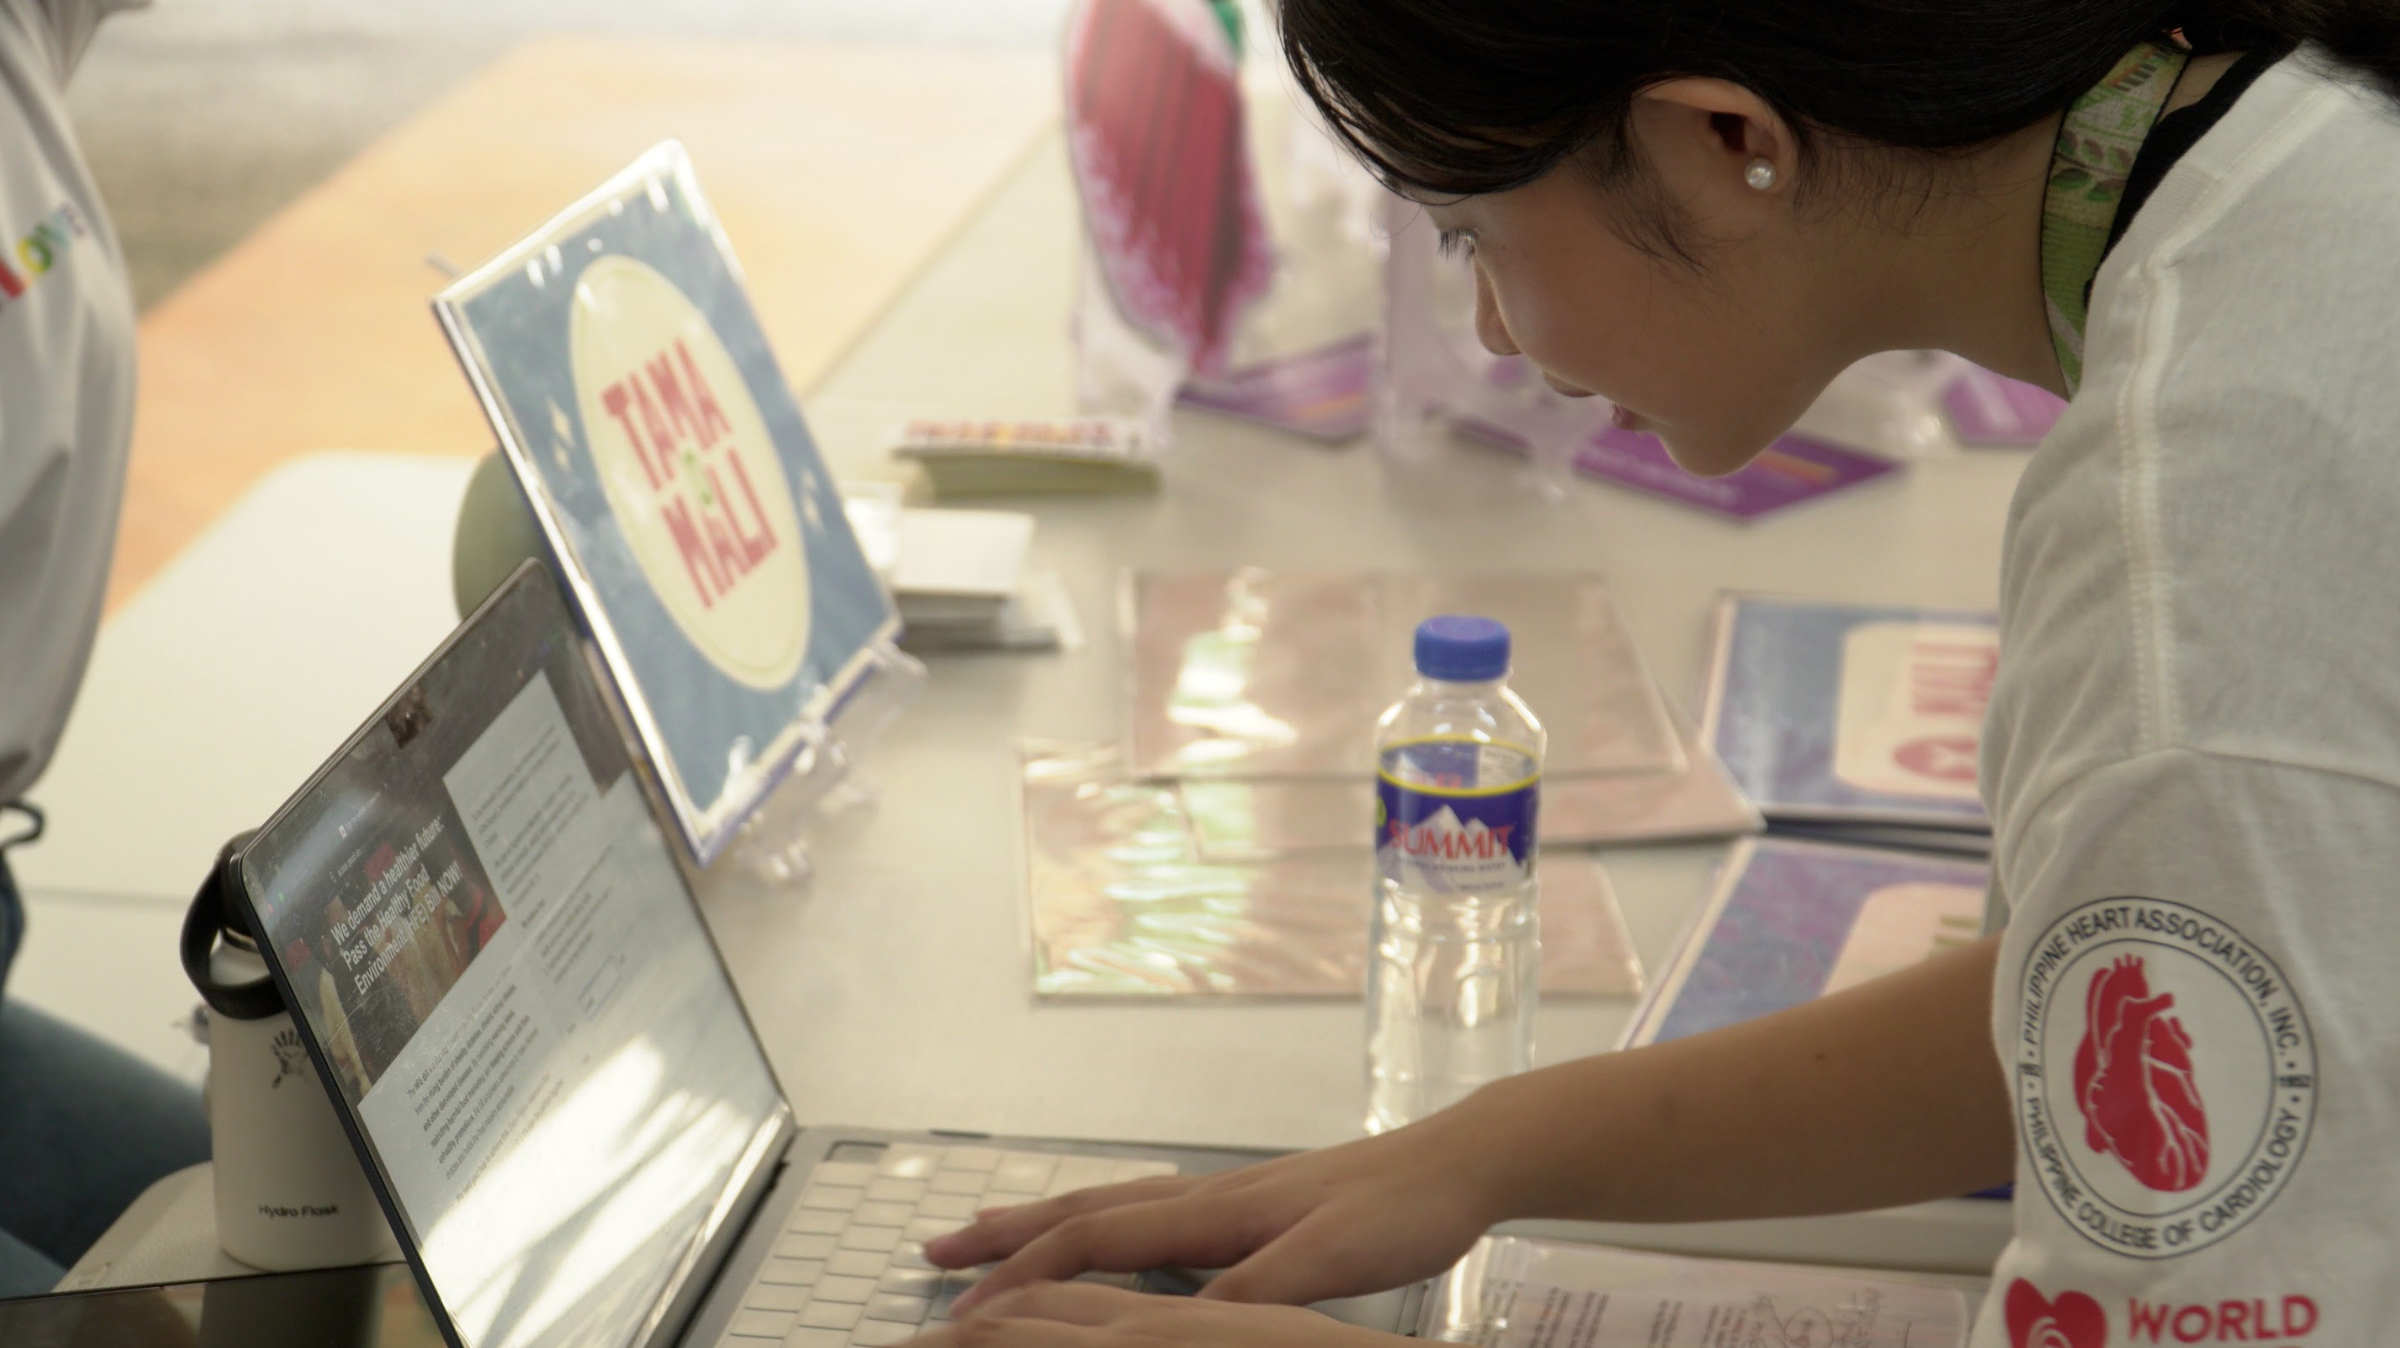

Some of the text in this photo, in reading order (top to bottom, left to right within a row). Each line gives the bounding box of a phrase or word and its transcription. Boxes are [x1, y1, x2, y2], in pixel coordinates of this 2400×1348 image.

[602, 338, 732, 491] TAMA
[661, 447, 778, 610] MALI
[330, 810, 444, 948] We demand a healthier future:
[1389, 819, 1514, 859] SUMMIT
[341, 861, 430, 972] Pass the Healthy Food
[353, 858, 463, 996] Environment (HFE) Bill NOW!
[2024, 906, 2301, 1056] PHILIPPINE HEART ASSOCIATION, INC.
[421, 1093, 430, 1106] the
[437, 1065, 451, 1086] burden
[421, 1116, 431, 1132] and
[428, 1105, 440, 1123] other
[429, 1120, 450, 1151] restricting
[446, 1104, 462, 1127] harmful
[459, 1093, 469, 1110] food
[259, 1204, 338, 1218] Hydro Flask
[2026, 1095, 2302, 1250] PHILIPPINE COLLEGE OF CARDIOLOGY
[2128, 1295, 2319, 1343] WORLD
